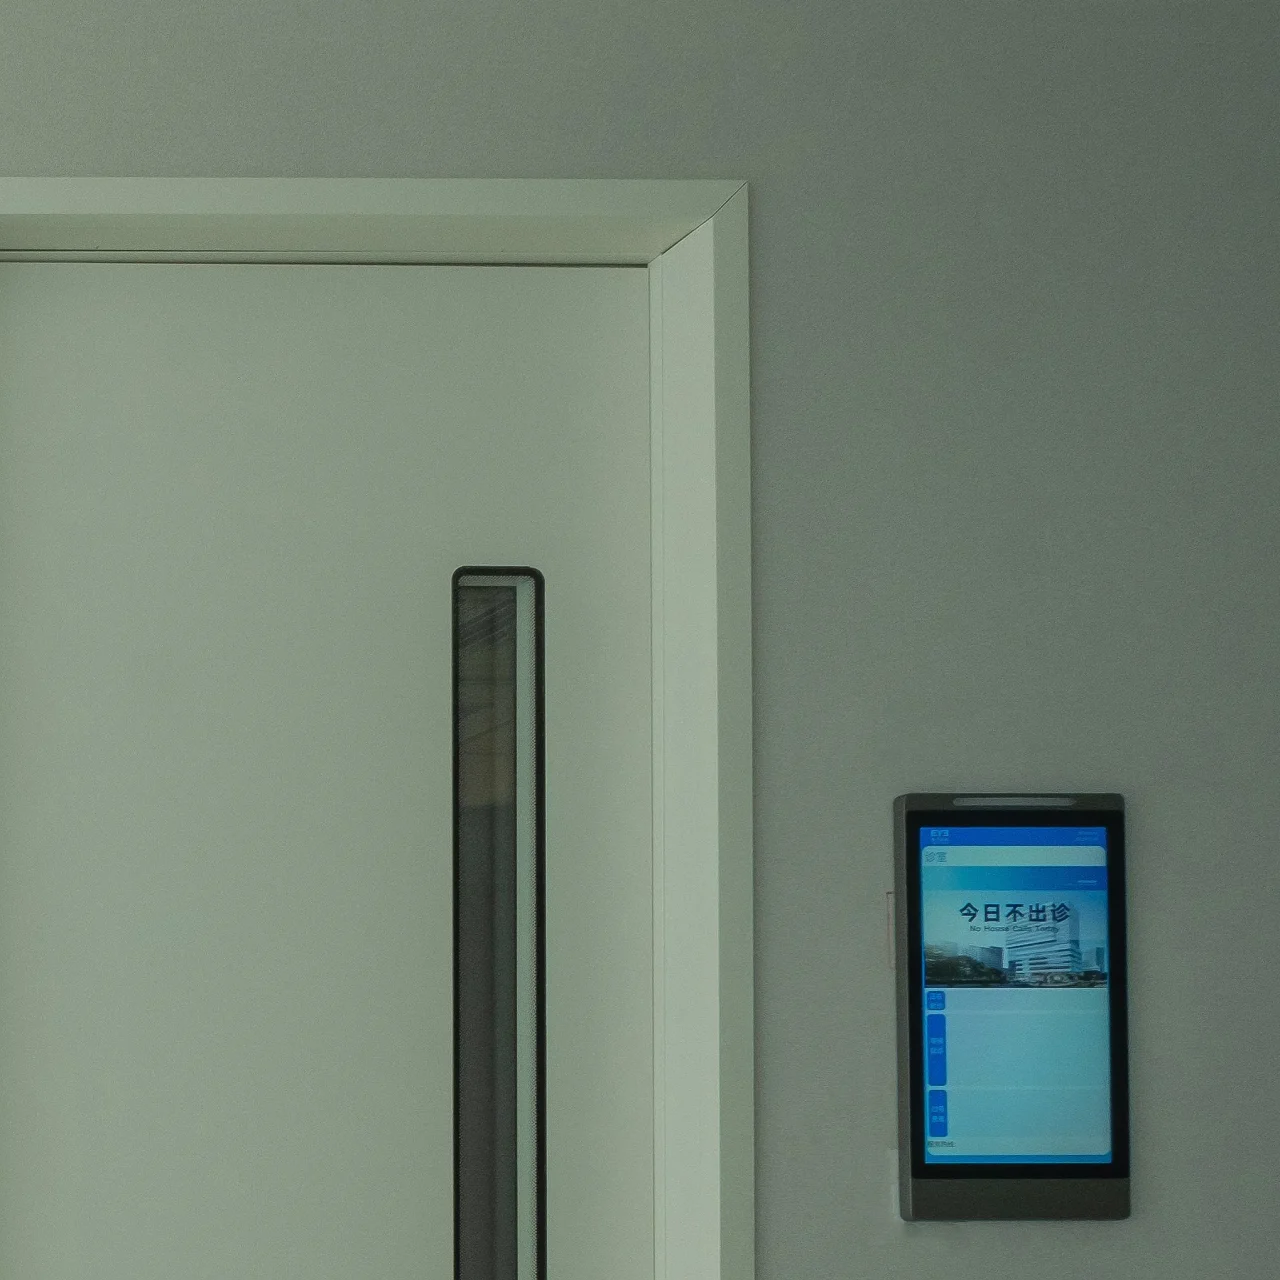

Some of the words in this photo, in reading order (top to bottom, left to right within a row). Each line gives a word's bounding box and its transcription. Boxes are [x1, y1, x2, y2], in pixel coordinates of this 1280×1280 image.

[959, 902, 1071, 922] 今日不出诊
